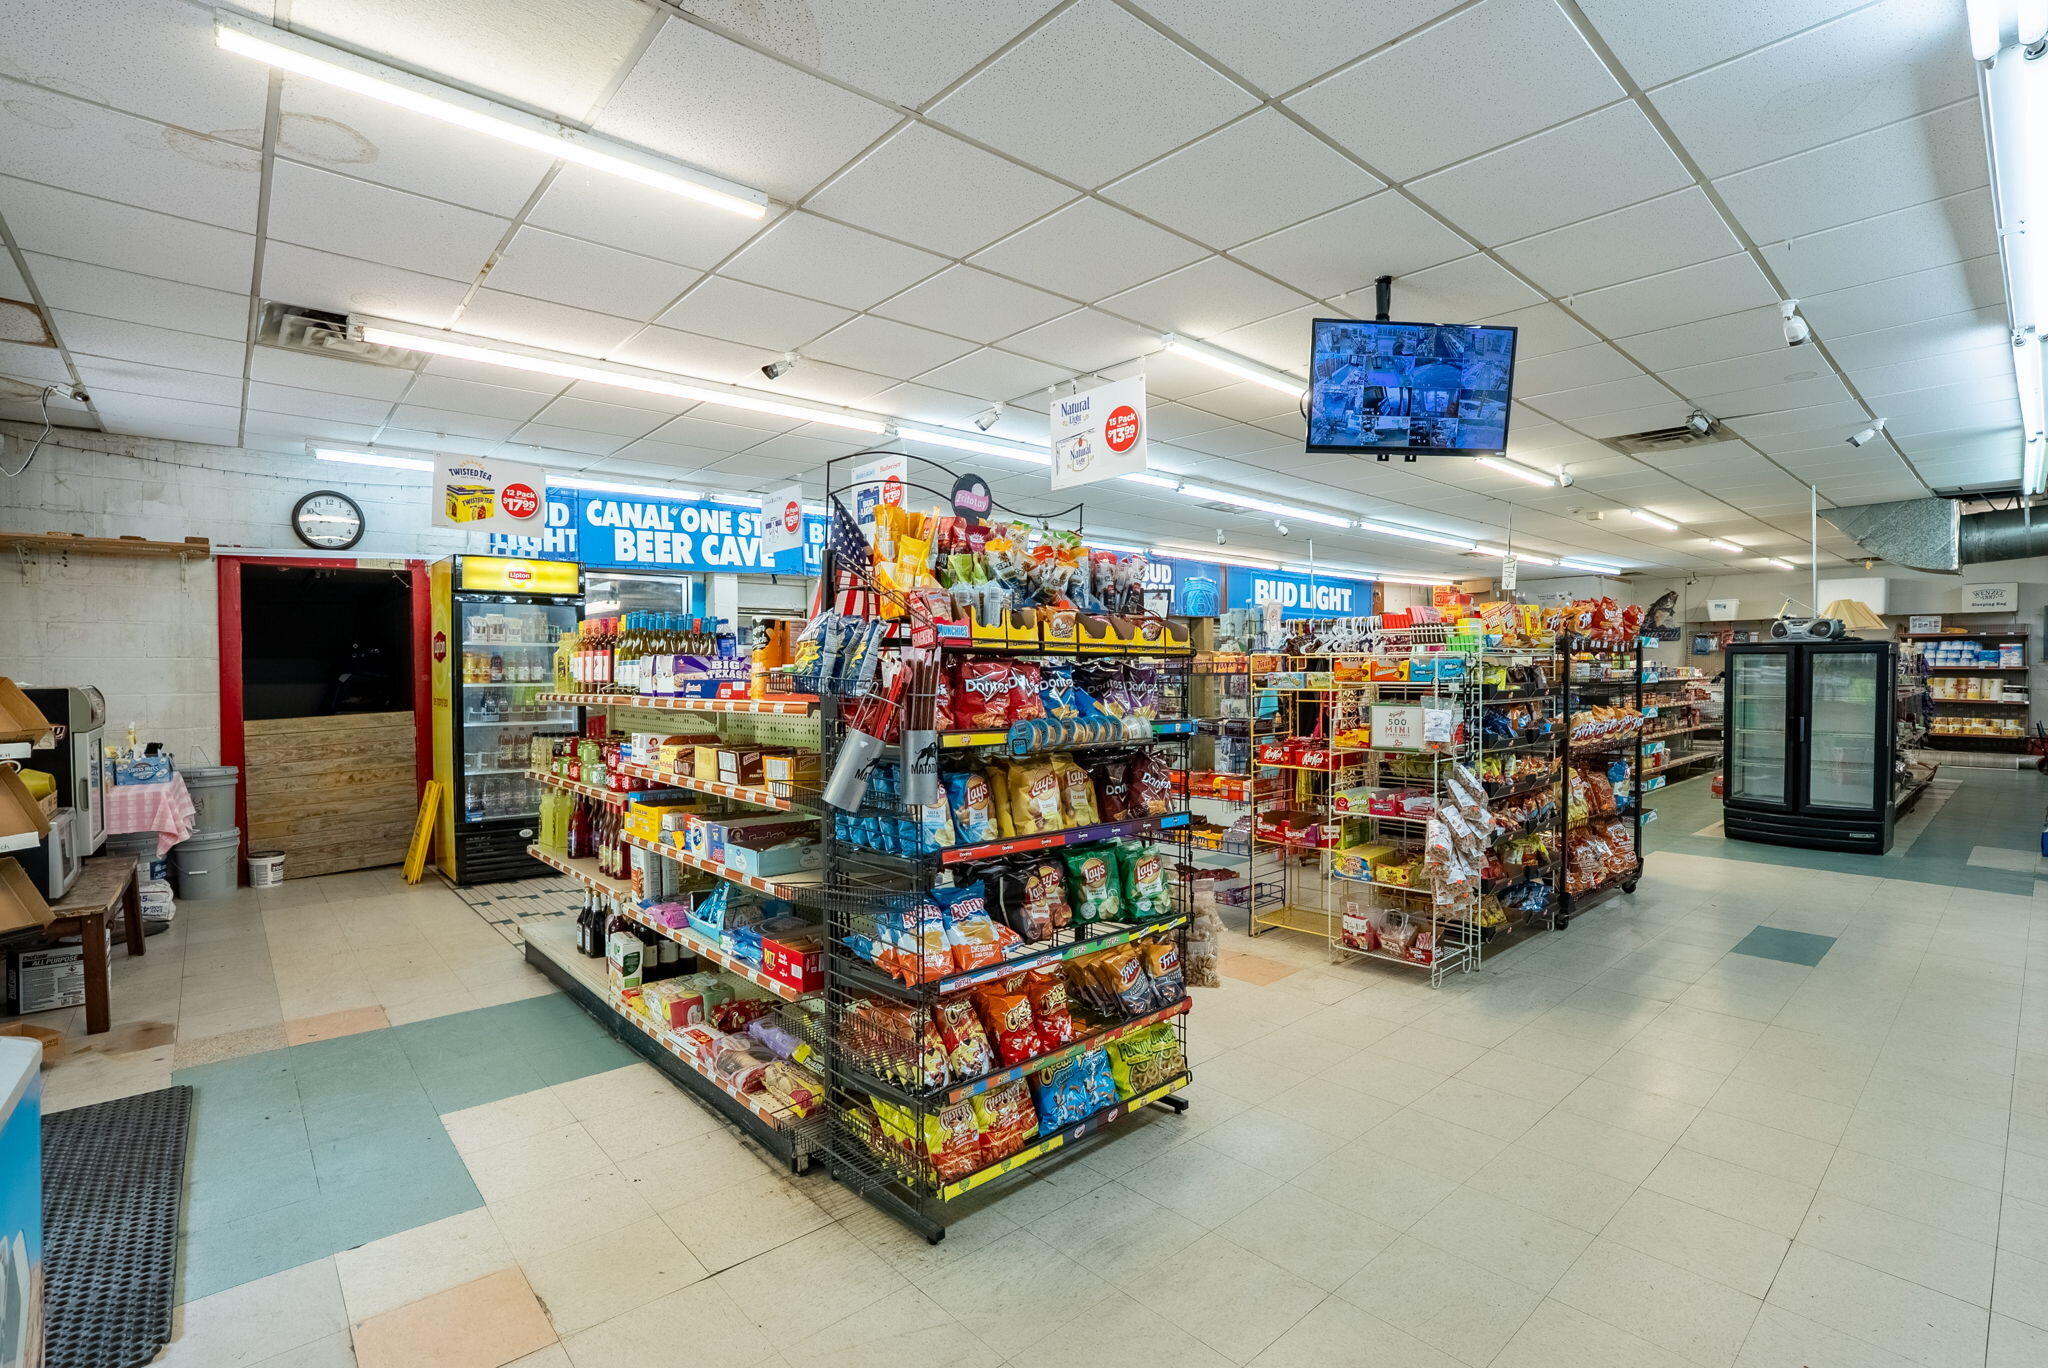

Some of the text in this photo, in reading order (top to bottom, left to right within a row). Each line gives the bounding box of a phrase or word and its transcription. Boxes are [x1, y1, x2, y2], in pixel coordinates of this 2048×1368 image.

[1061, 396, 1090, 417] Natural
[1108, 412, 1136, 427] 15 Pack
[448, 468, 478, 477] TWISTED
[479, 470, 492, 482] TEA
[517, 490, 536, 498] Pack
[586, 500, 675, 531] CANAL
[680, 507, 732, 535] ONE
[614, 529, 695, 564] BEER
[509, 572, 531, 580] Lipton
[1254, 579, 1351, 612] BUD LIGHT
[1972, 589, 2006, 599] WENZEL
[937, 625, 968, 637] MUNCHIES
[711, 659, 740, 670] BIG
[707, 669, 740, 680] TEXAS
[965, 676, 1009, 693] Doritos
[1388, 718, 1407, 726] 500
[1031, 773, 1055, 797] Lay's
[1066, 770, 1088, 787] Lay's
[967, 782, 989, 804] Lay's
[1085, 864, 1106, 883] Lay's
[1137, 858, 1159, 880] Lay's
[46, 955, 78, 965] PURPOSE
